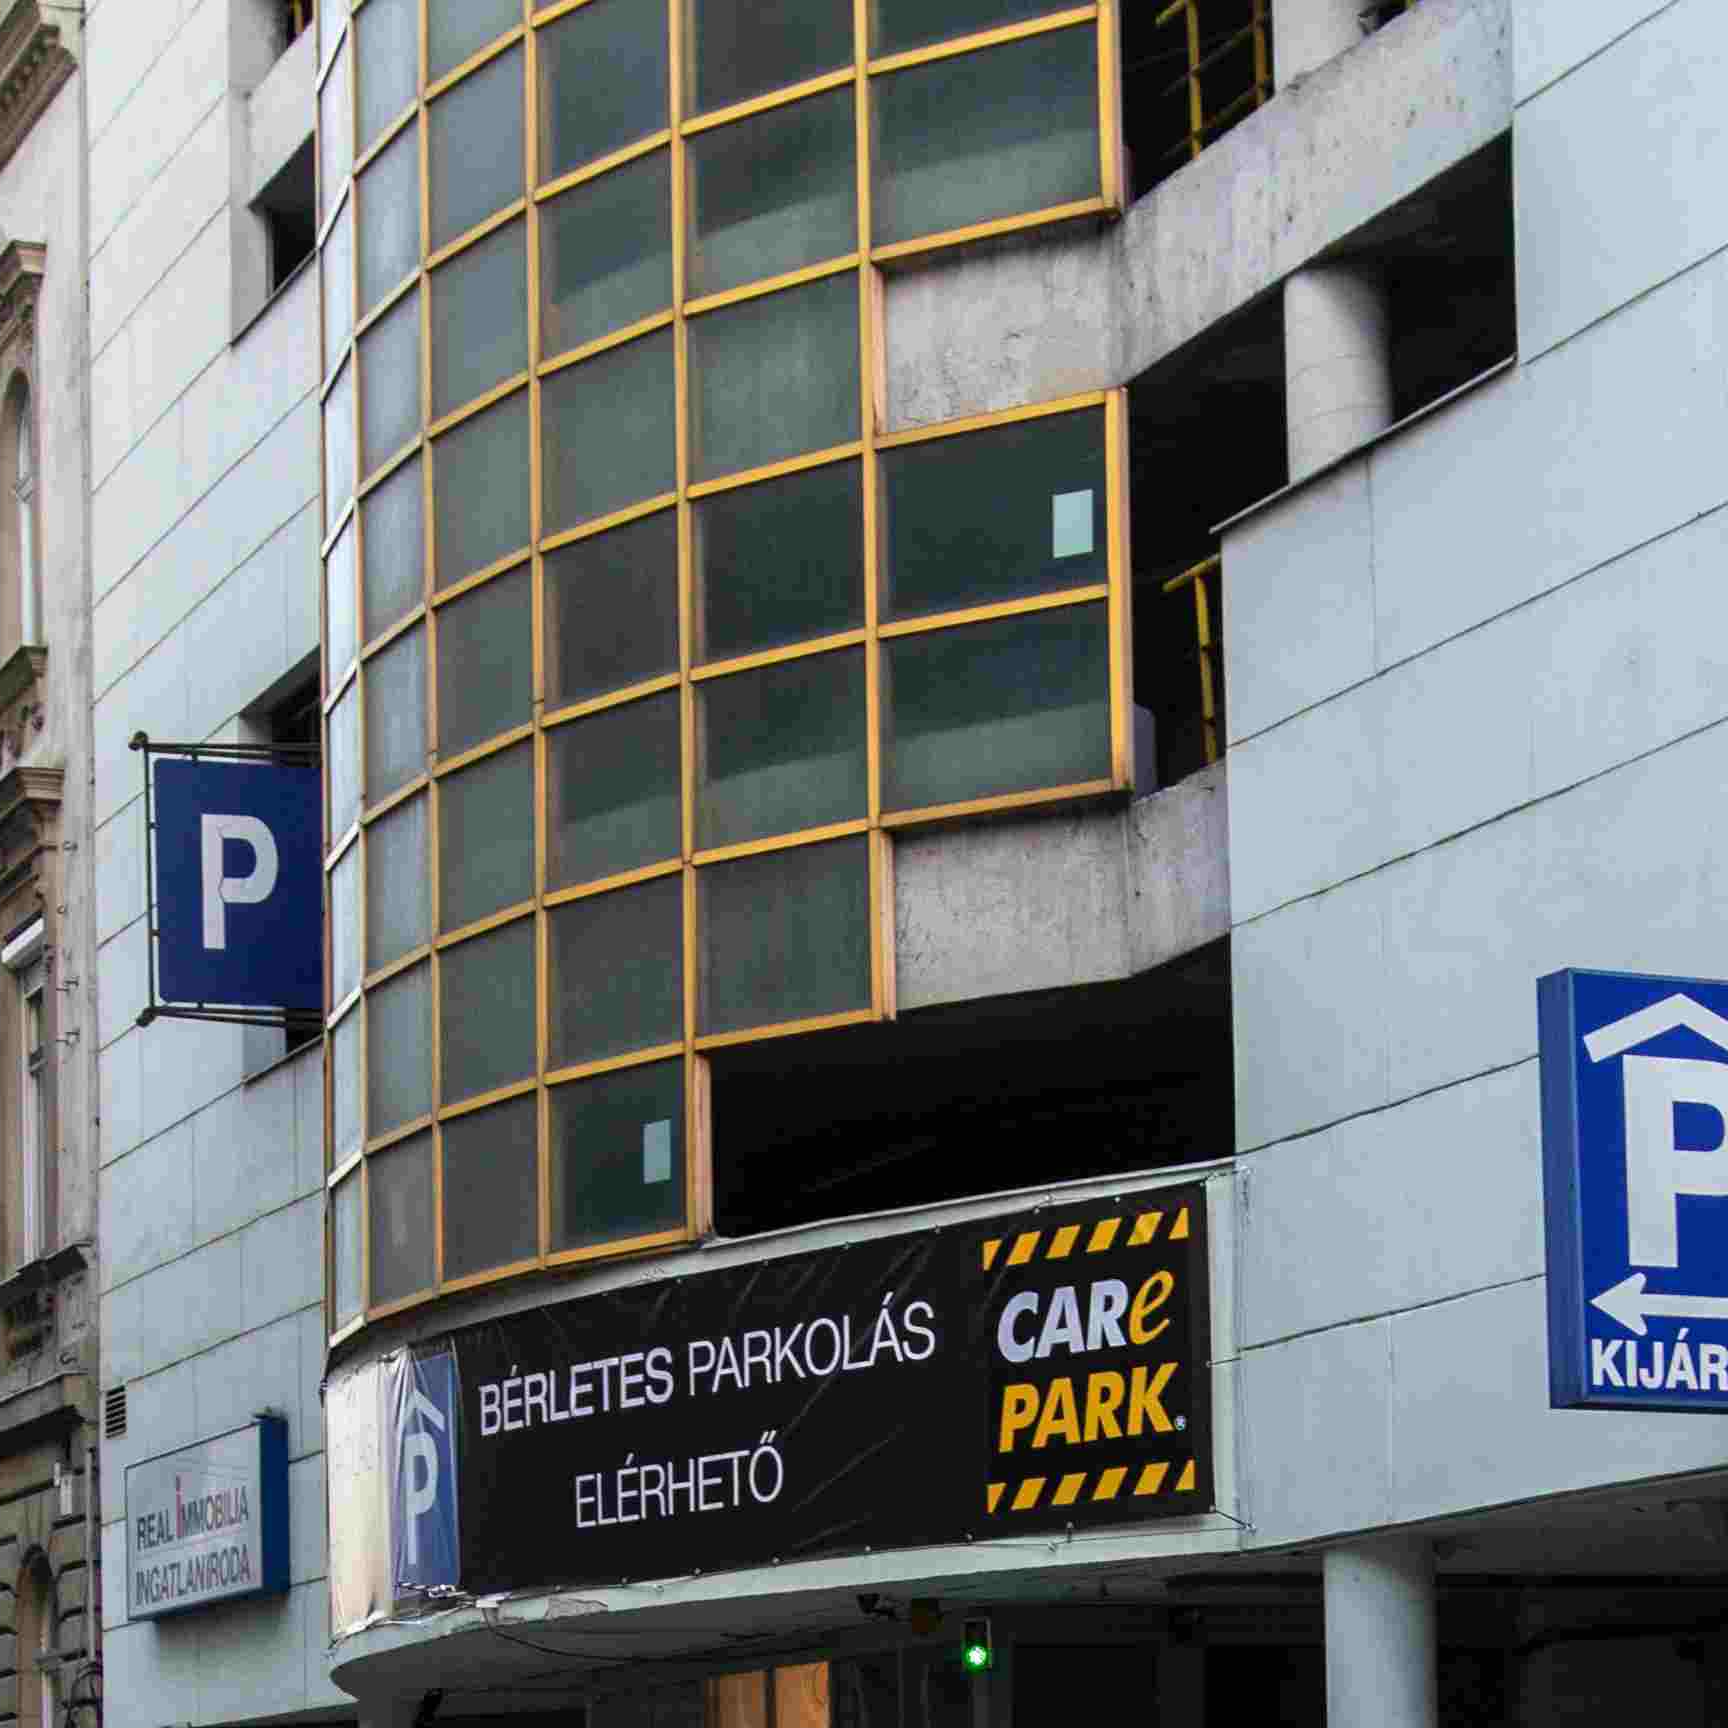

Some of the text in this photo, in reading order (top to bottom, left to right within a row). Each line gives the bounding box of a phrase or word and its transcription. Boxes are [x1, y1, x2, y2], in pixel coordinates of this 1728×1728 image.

[200, 812, 280, 950] P
[997, 1269, 1175, 1363] CARe
[478, 1291, 936, 1436] BÉRLETES PARKOLÁS
[998, 1361, 1179, 1453] PARK
[575, 1429, 784, 1529] ELÉRHETŐ
[136, 1509, 173, 1551] REAL
[136, 1544, 251, 1606] INGATLANIRODA
